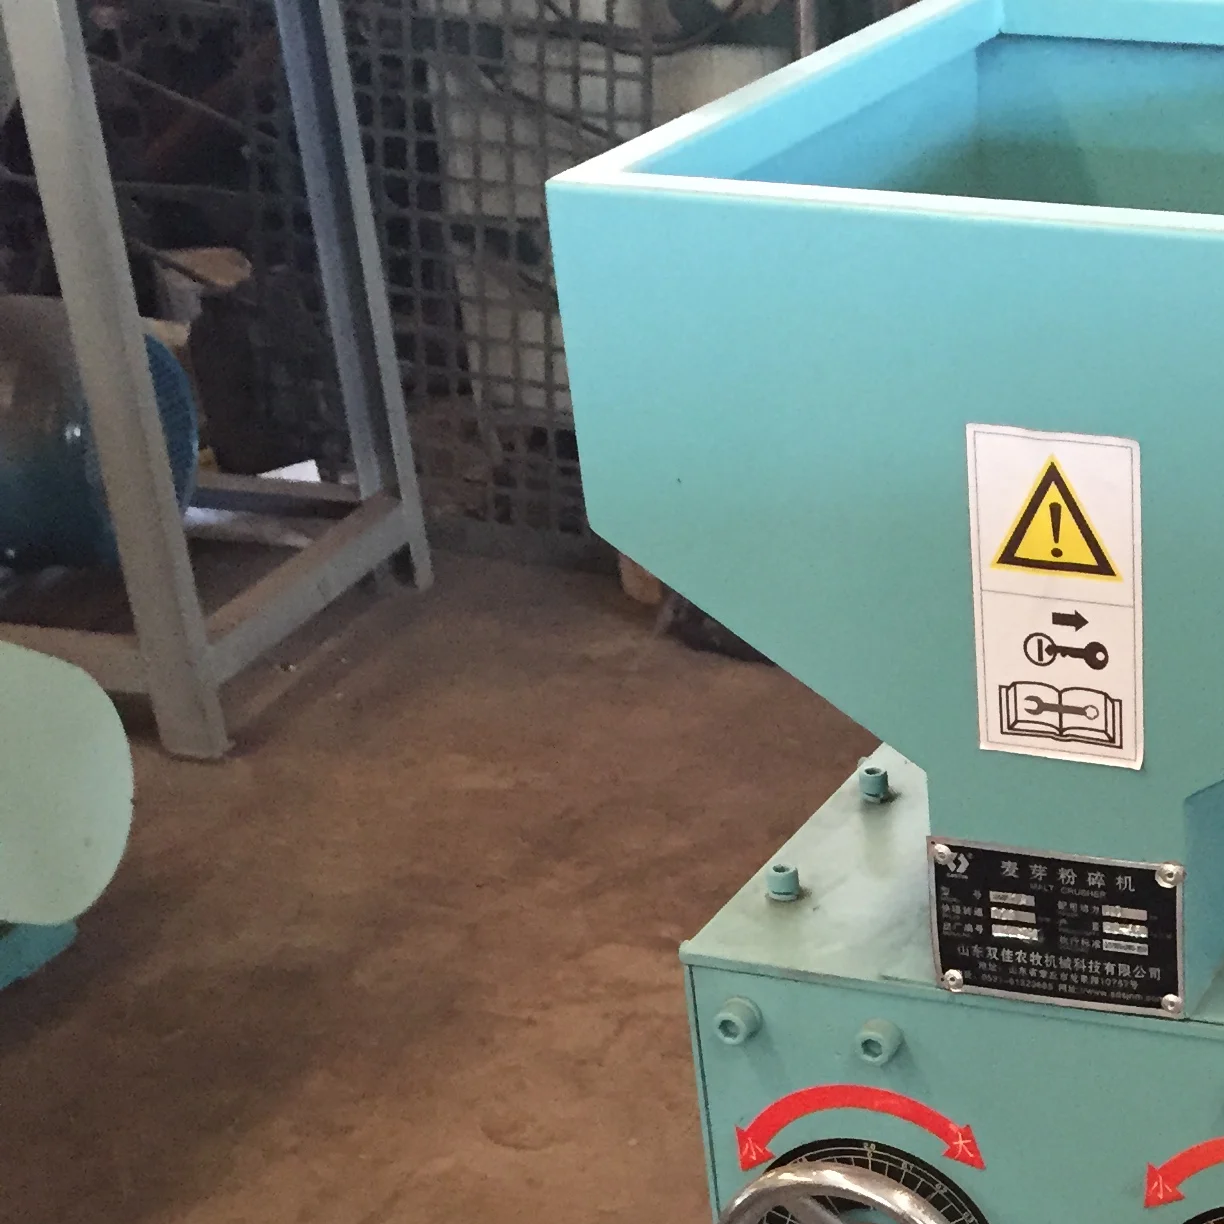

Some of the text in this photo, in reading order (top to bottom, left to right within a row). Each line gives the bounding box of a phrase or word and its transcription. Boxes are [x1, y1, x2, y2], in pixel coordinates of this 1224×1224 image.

[1001, 860, 1136, 892] 麦芽粉碎机
[1060, 886, 1107, 898] CRUSHER
[957, 946, 1161, 981] 山东双佳农牧机械科技有限公司
[743, 1136, 764, 1160] 小
[952, 1131, 974, 1159] 大
[1151, 1175, 1172, 1200] 小
